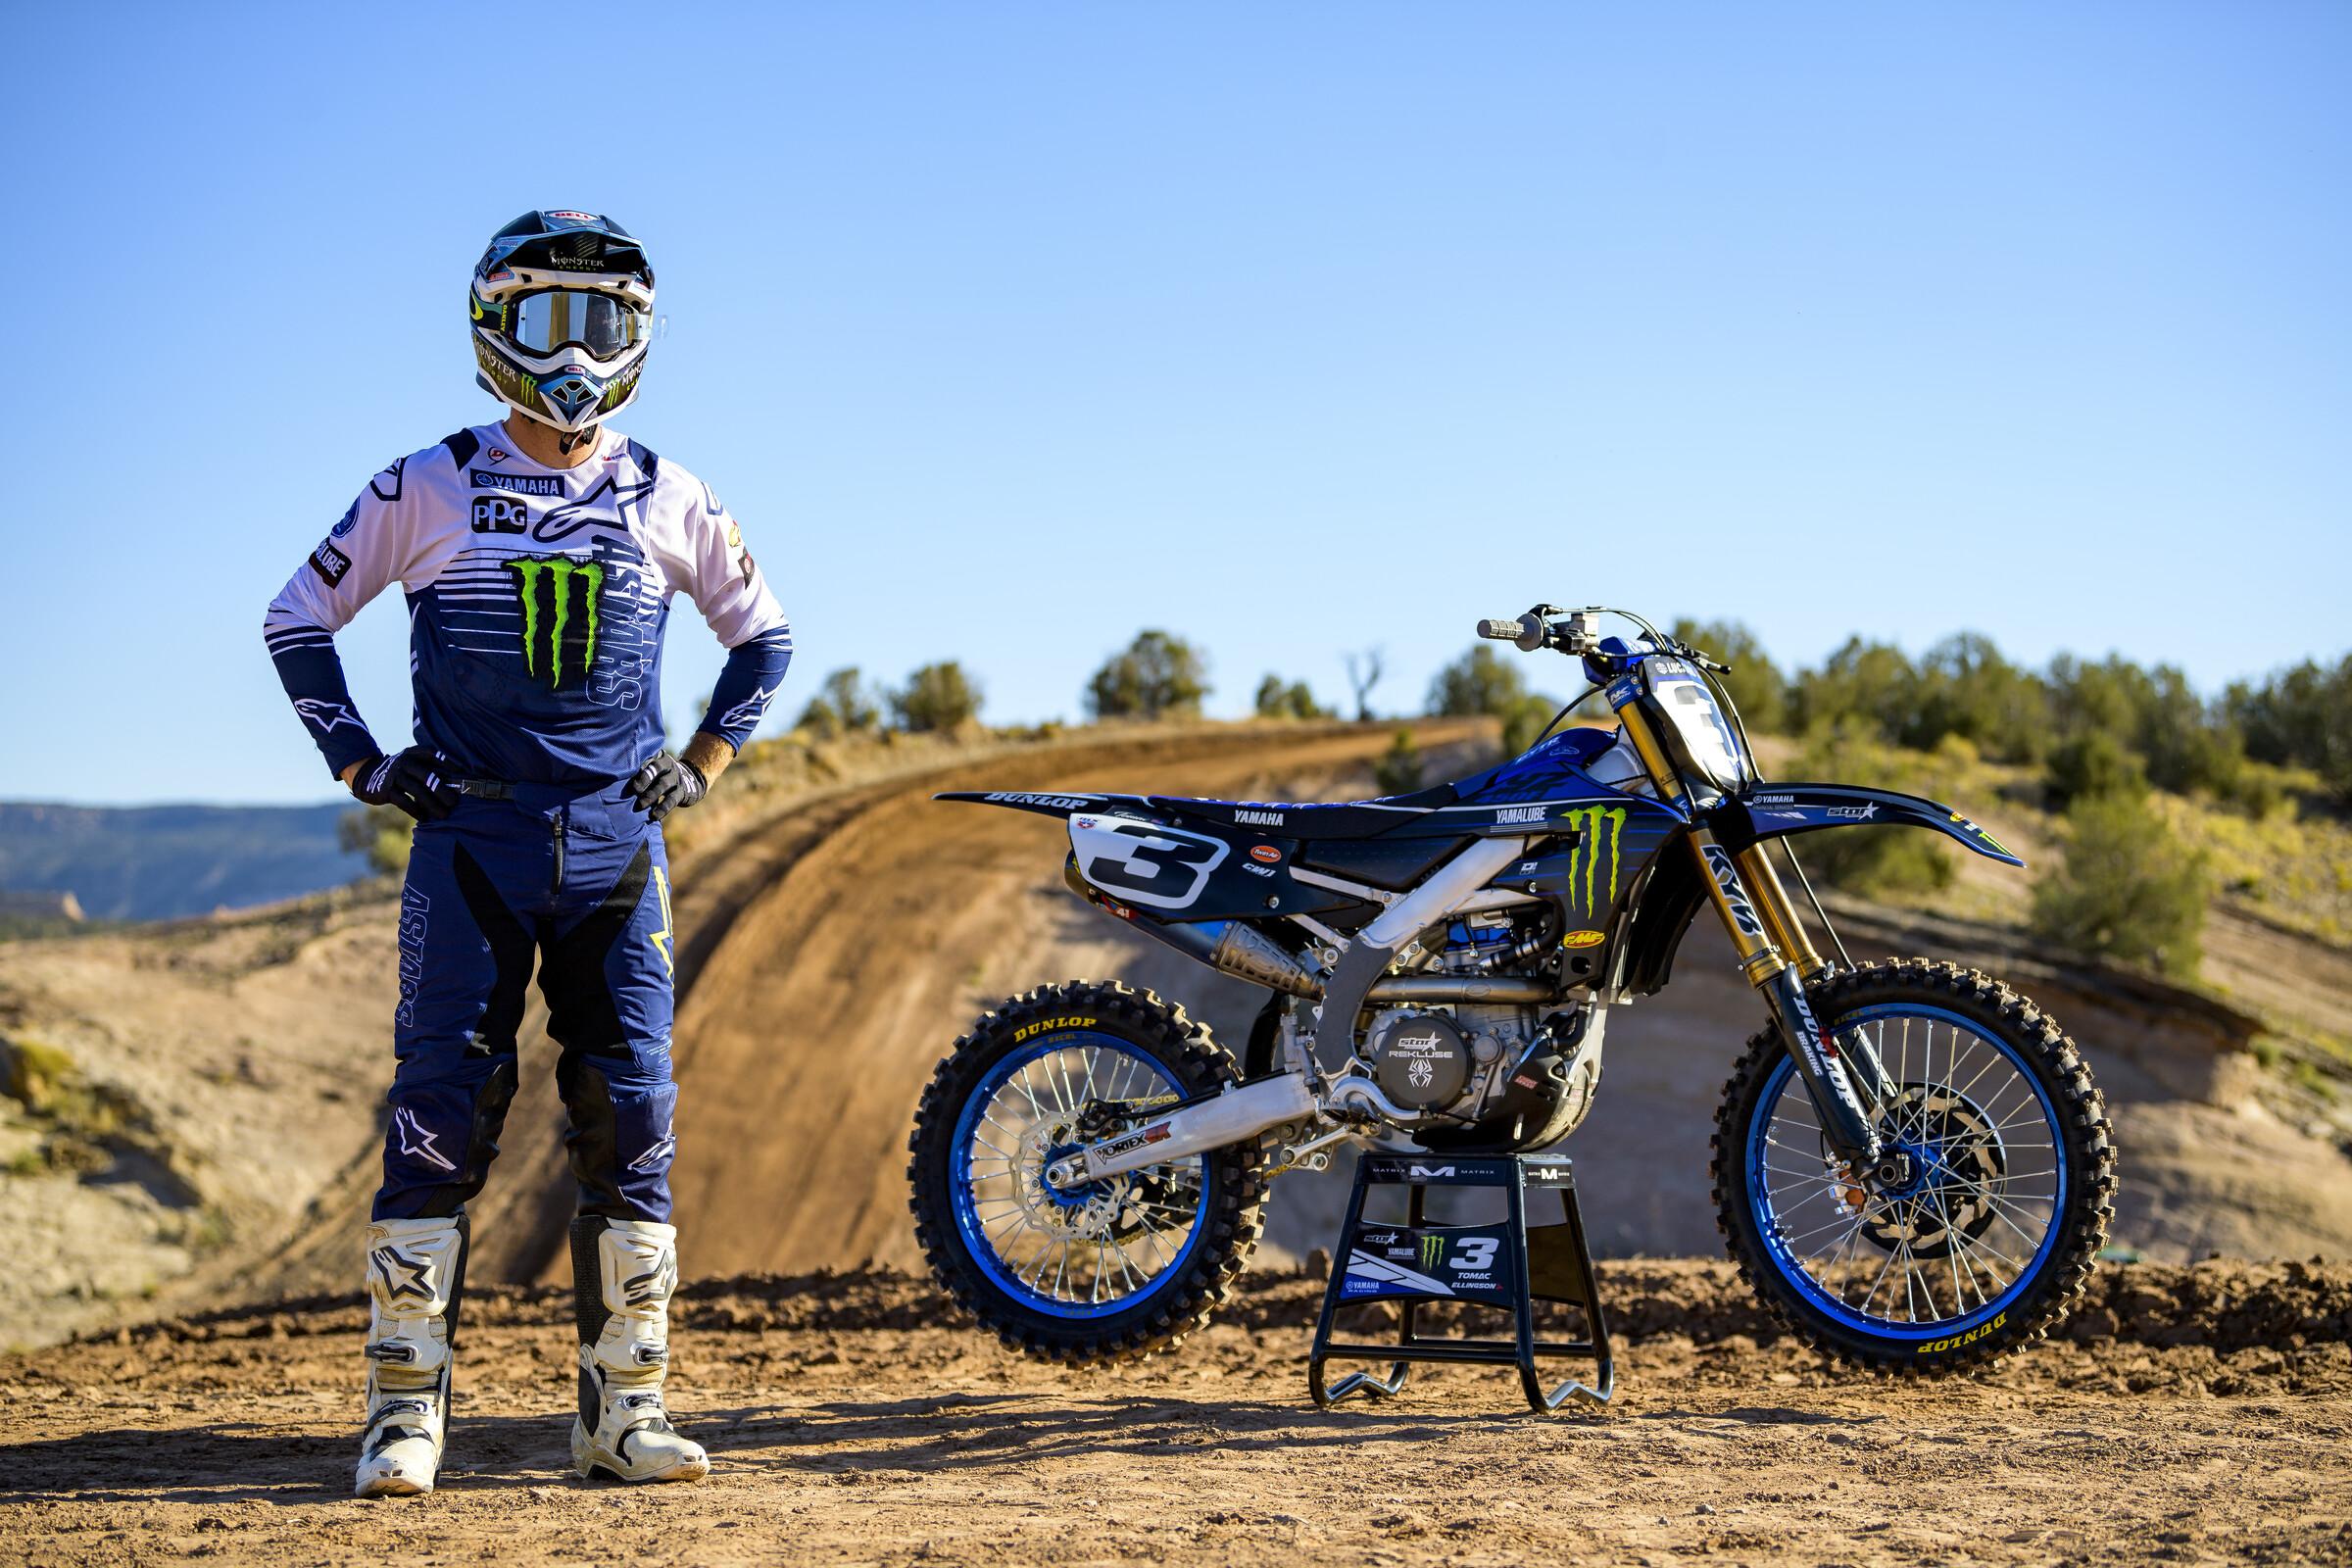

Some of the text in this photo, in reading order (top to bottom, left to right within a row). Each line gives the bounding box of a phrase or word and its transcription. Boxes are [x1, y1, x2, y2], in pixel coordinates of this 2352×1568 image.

[551, 256, 605, 268] MONSTER
[494, 476, 560, 495] YAMAHA
[473, 499, 526, 530] PPG
[984, 792, 1089, 809] DUNLOP
[1763, 795, 1794, 804] YAMAHA
[1235, 809, 1284, 826] YAMAHA
[1496, 807, 1546, 824] YAMALUBE
[1088, 824, 1220, 899] 3
[1564, 932, 1604, 945] FMF
[1013, 1016, 1098, 1043] DUNLOP
[1792, 997, 1858, 1109] DUNLOP
[1795, 1031, 1824, 1077] BRAKING
[1094, 1131, 1150, 1164] VORTEX
[1388, 1248, 1415, 1256] YAMALUBE
[1448, 1237, 1500, 1270] 3
[1353, 1281, 1380, 1290] YAMAHA
[1917, 1311, 2007, 1353] DUNLOP
